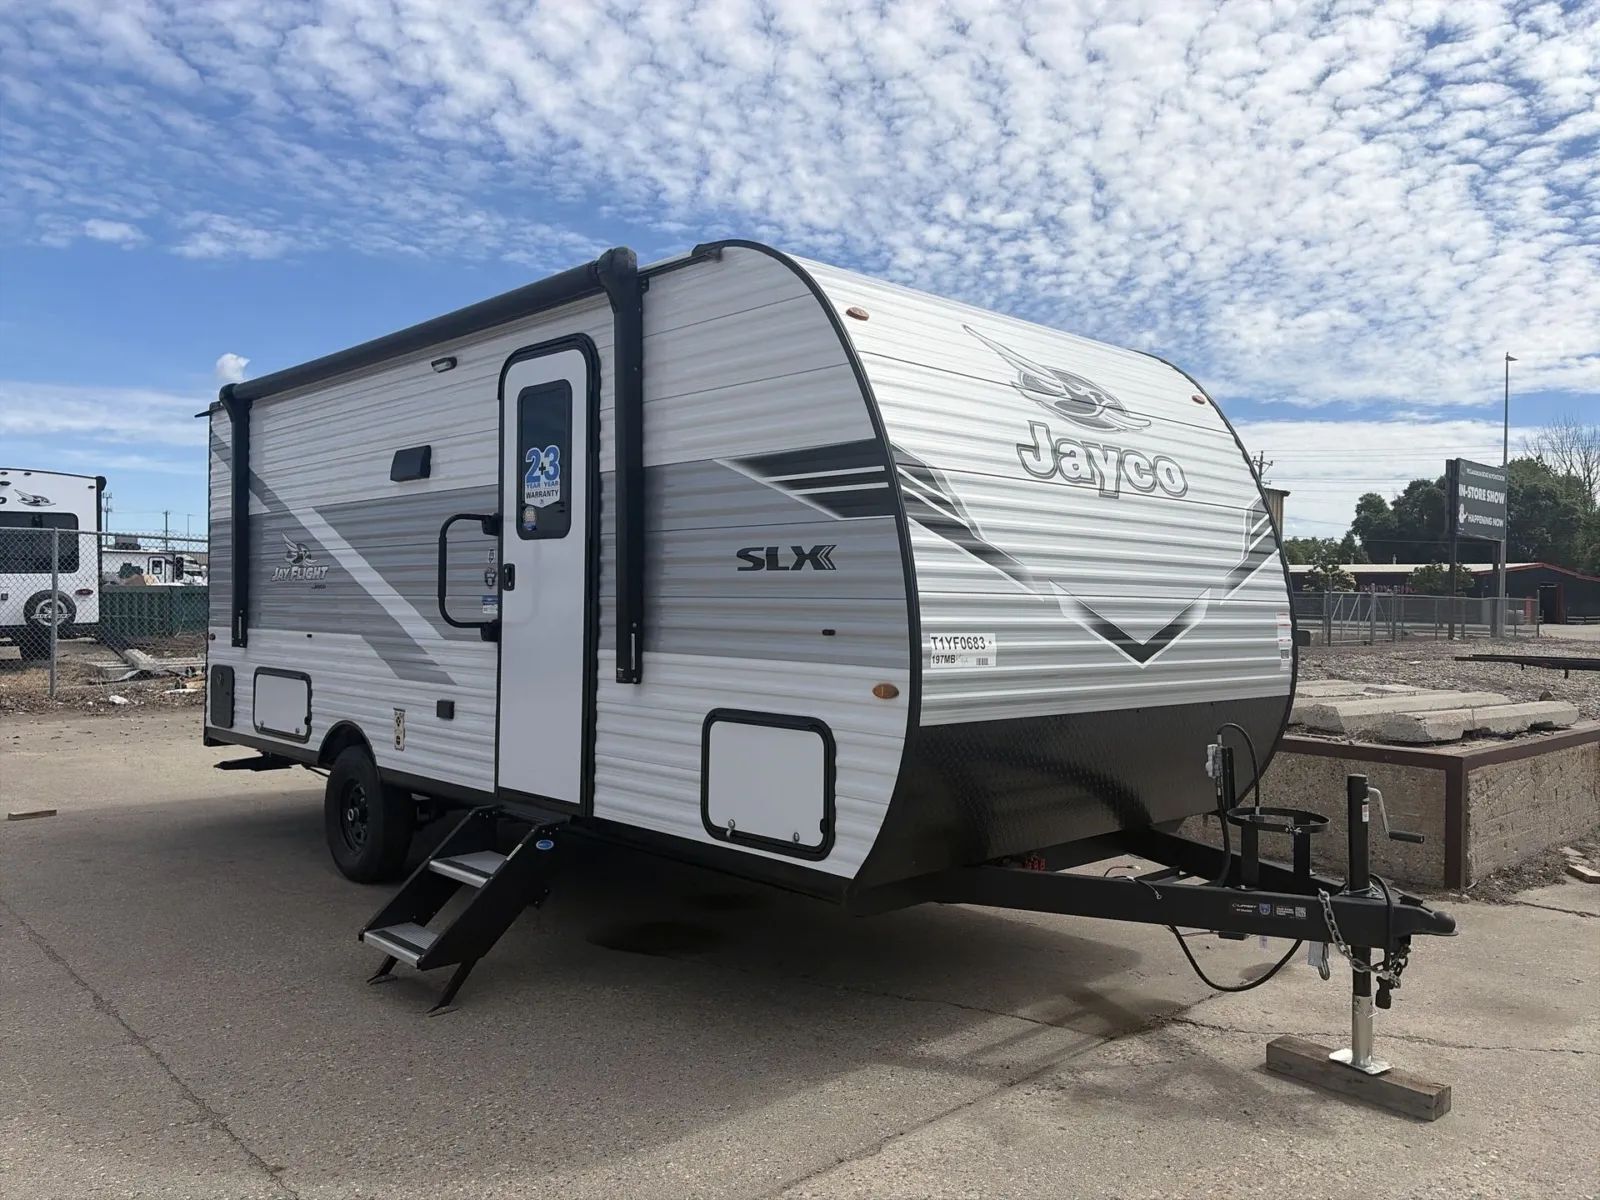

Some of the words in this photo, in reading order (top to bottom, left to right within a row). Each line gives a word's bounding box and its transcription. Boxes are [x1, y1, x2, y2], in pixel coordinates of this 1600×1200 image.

[1016, 420, 1188, 499] Jayco
[526, 489, 559, 499] WARRANTY
[1458, 484, 1486, 501] IN-STORE
[1487, 489, 1505, 504] SHOW
[1468, 514, 1493, 526] HAPPENING
[1493, 518, 1504, 527] NOW
[736, 545, 837, 571] SLX
[271, 567, 290, 582] JAY
[290, 565, 329, 581] FLIGHT
[931, 636, 986, 650] T1YF0683
[932, 655, 956, 664] 197MB
